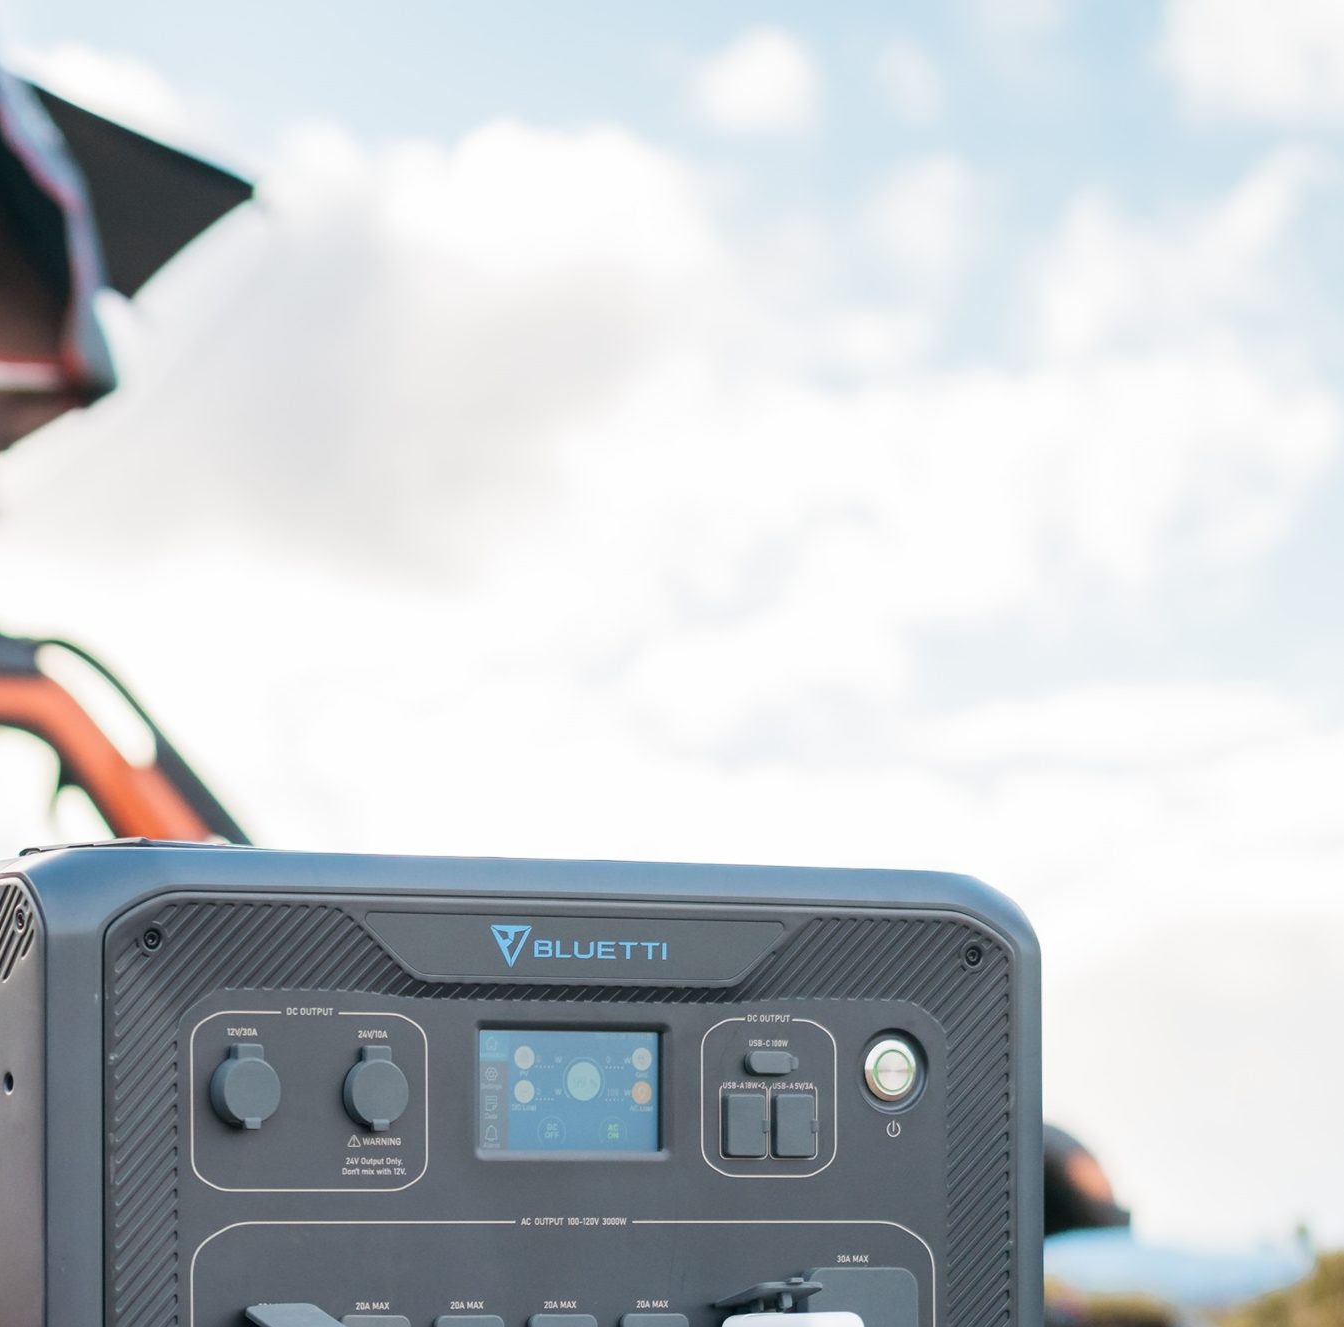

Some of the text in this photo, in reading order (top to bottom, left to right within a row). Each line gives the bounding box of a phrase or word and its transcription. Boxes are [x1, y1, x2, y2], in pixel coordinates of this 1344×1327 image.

[533, 940, 668, 961] BLUETTI
[286, 1008, 334, 1016] DC OUTPUT
[747, 1014, 790, 1023] DC OUTPUT
[227, 1027, 258, 1037] 12V/30A
[358, 1030, 388, 1039] 24V/10A
[362, 1137, 401, 1146] WARNING
[345, 1157, 403, 1166] 24V Output Only.
[521, 1218, 627, 1226] AC OUTPUT 100-120V 3000W
[837, 1255, 869, 1263] 30A MAX
[355, 1302, 390, 1310] 20A MAX
[450, 1301, 484, 1309] 20A MAX
[544, 1301, 577, 1309] 20A MAX
[636, 1300, 669, 1308] 20A MAX
